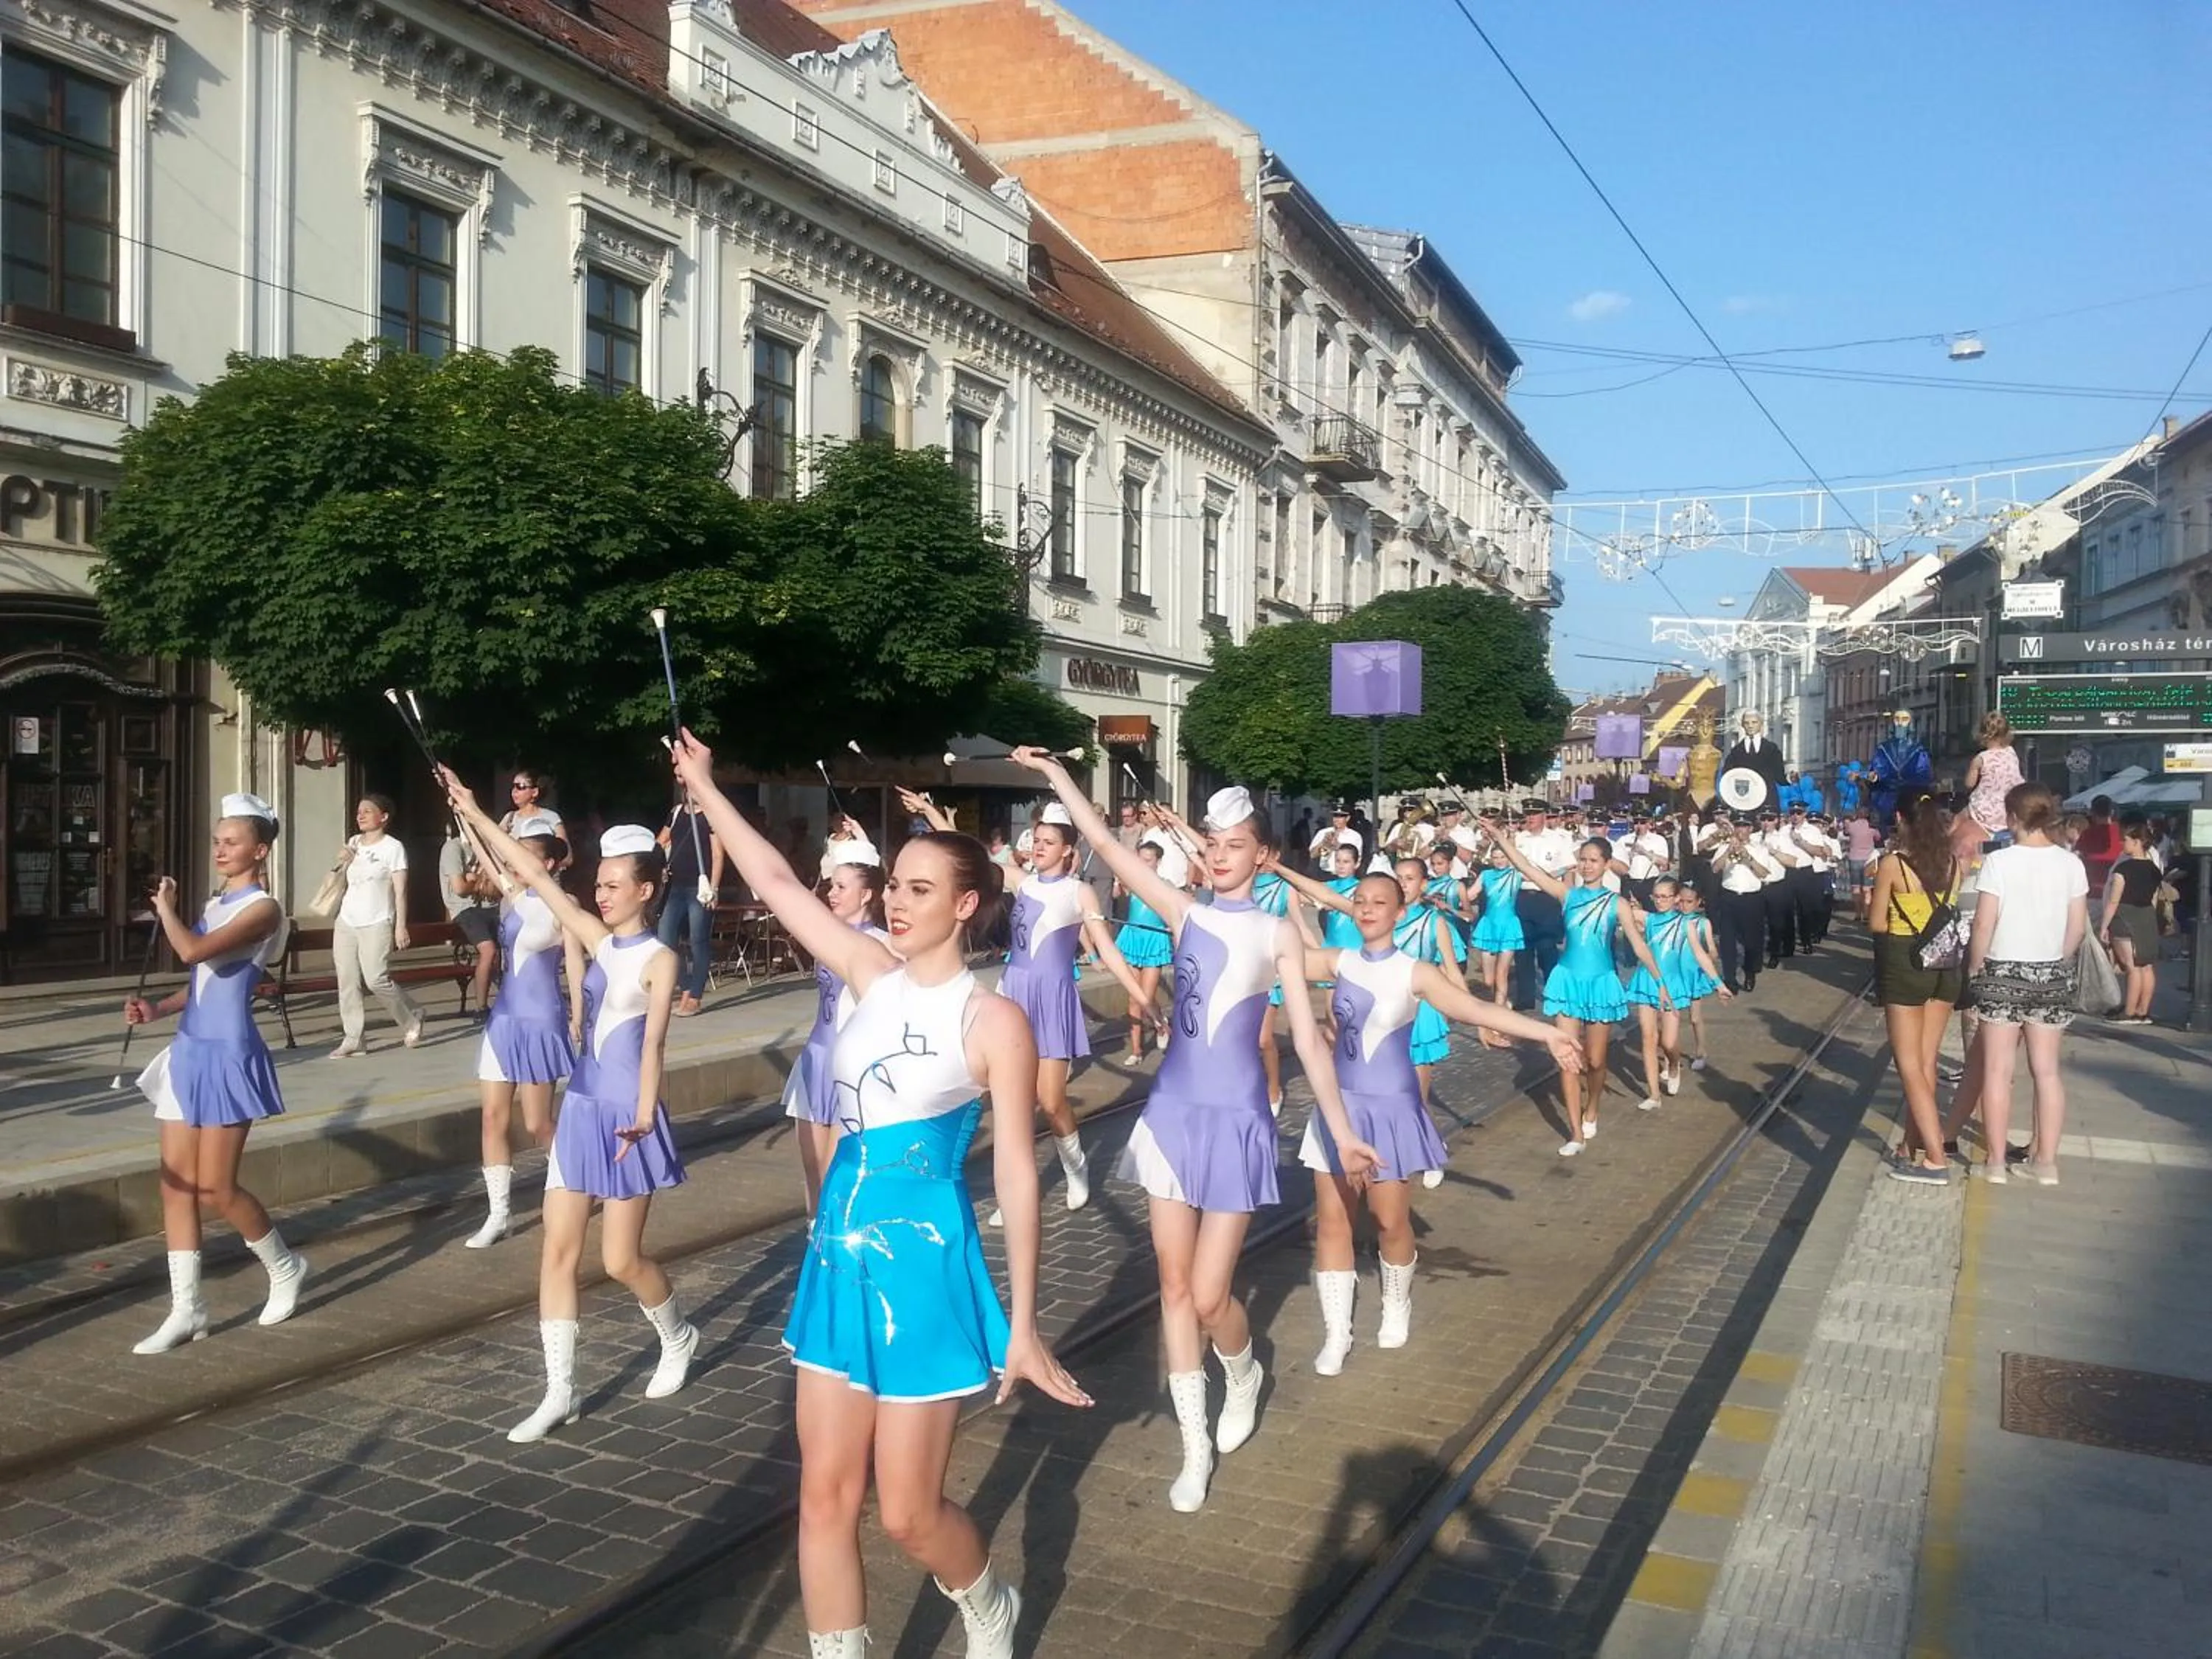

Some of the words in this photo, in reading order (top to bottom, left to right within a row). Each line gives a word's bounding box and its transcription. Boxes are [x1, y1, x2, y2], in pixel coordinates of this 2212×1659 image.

[0, 475, 111, 544] PTI
[2021, 637, 2042, 657] M
[2084, 638, 2177, 653] Városház
[2185, 636, 2212, 650] tér
